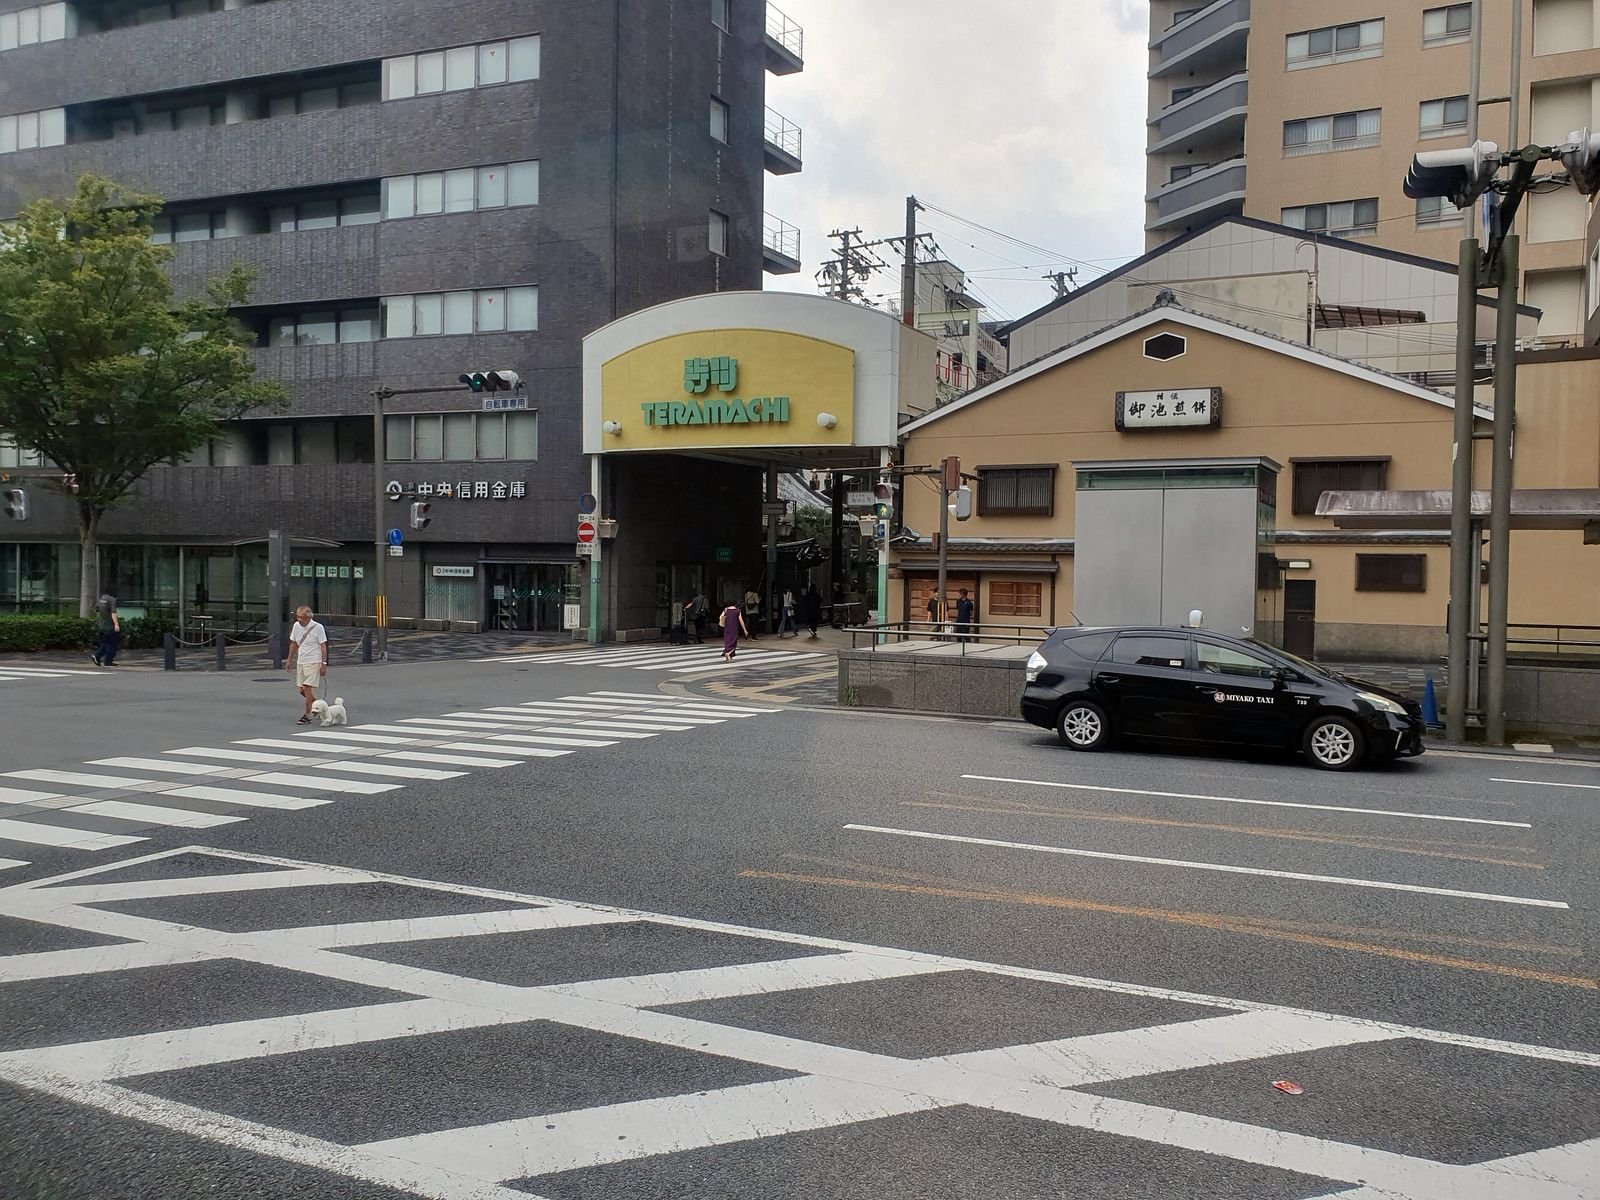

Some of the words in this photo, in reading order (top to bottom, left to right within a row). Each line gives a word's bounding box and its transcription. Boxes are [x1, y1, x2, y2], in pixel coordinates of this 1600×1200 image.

[641, 397, 790, 426] TERAMACHI
[1226, 694, 1254, 703] MIYAKO
[1256, 696, 1274, 704] TAXI
